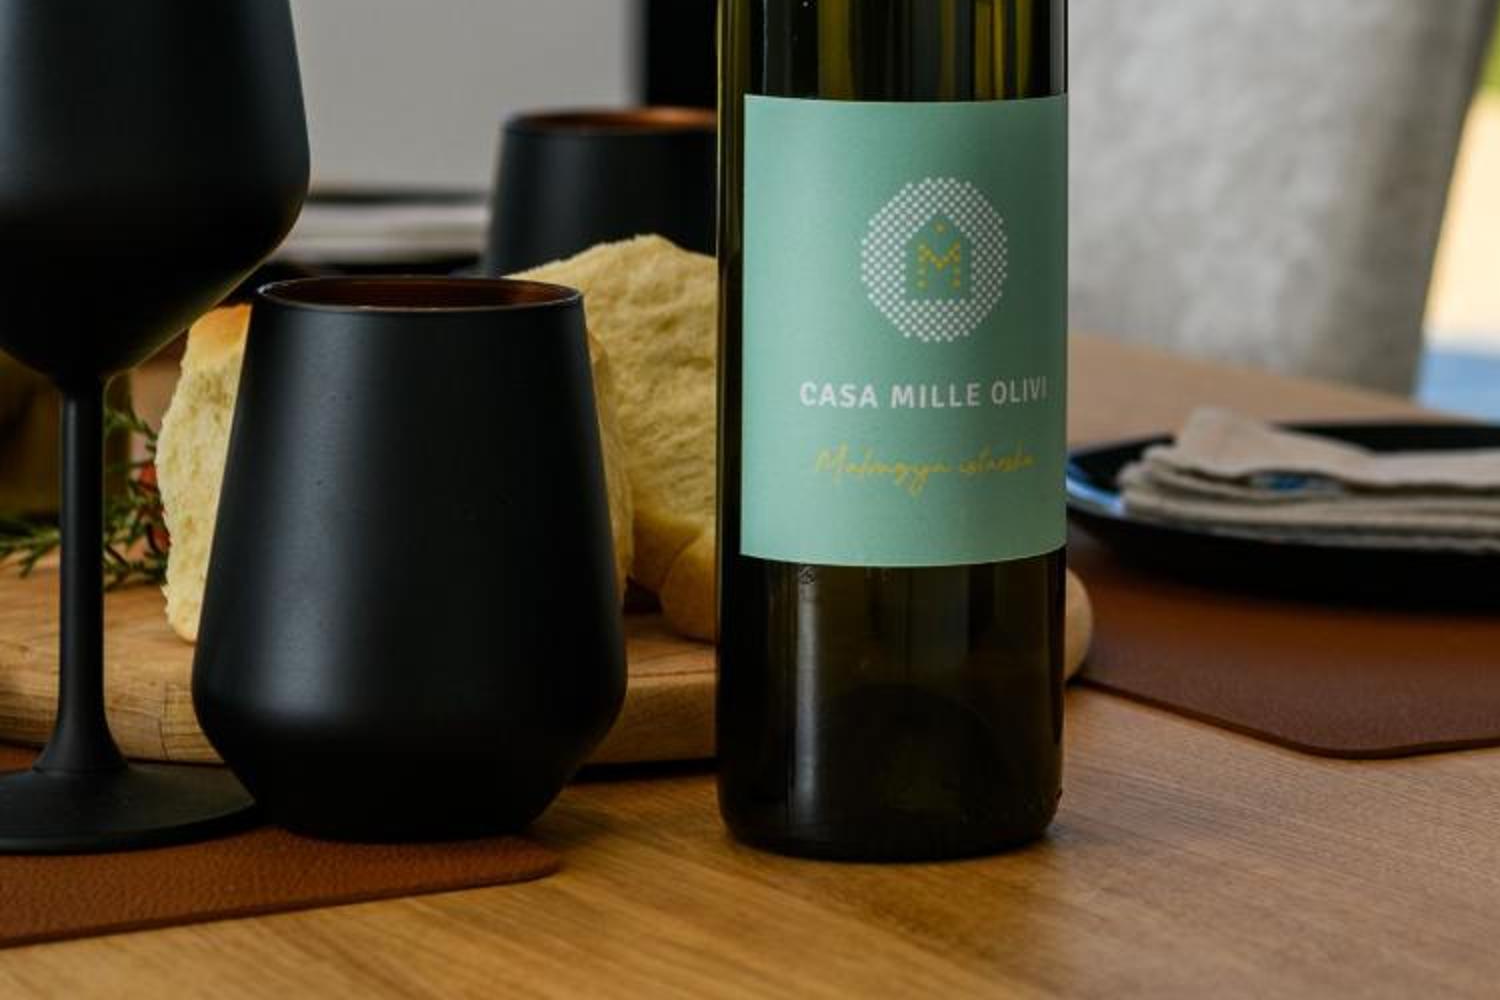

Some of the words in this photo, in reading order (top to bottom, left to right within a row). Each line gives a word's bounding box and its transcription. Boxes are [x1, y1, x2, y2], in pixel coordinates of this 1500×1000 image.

[799, 381, 879, 409] CASA
[891, 383, 980, 409] MILLE
[991, 376, 1047, 404] OLIVI
